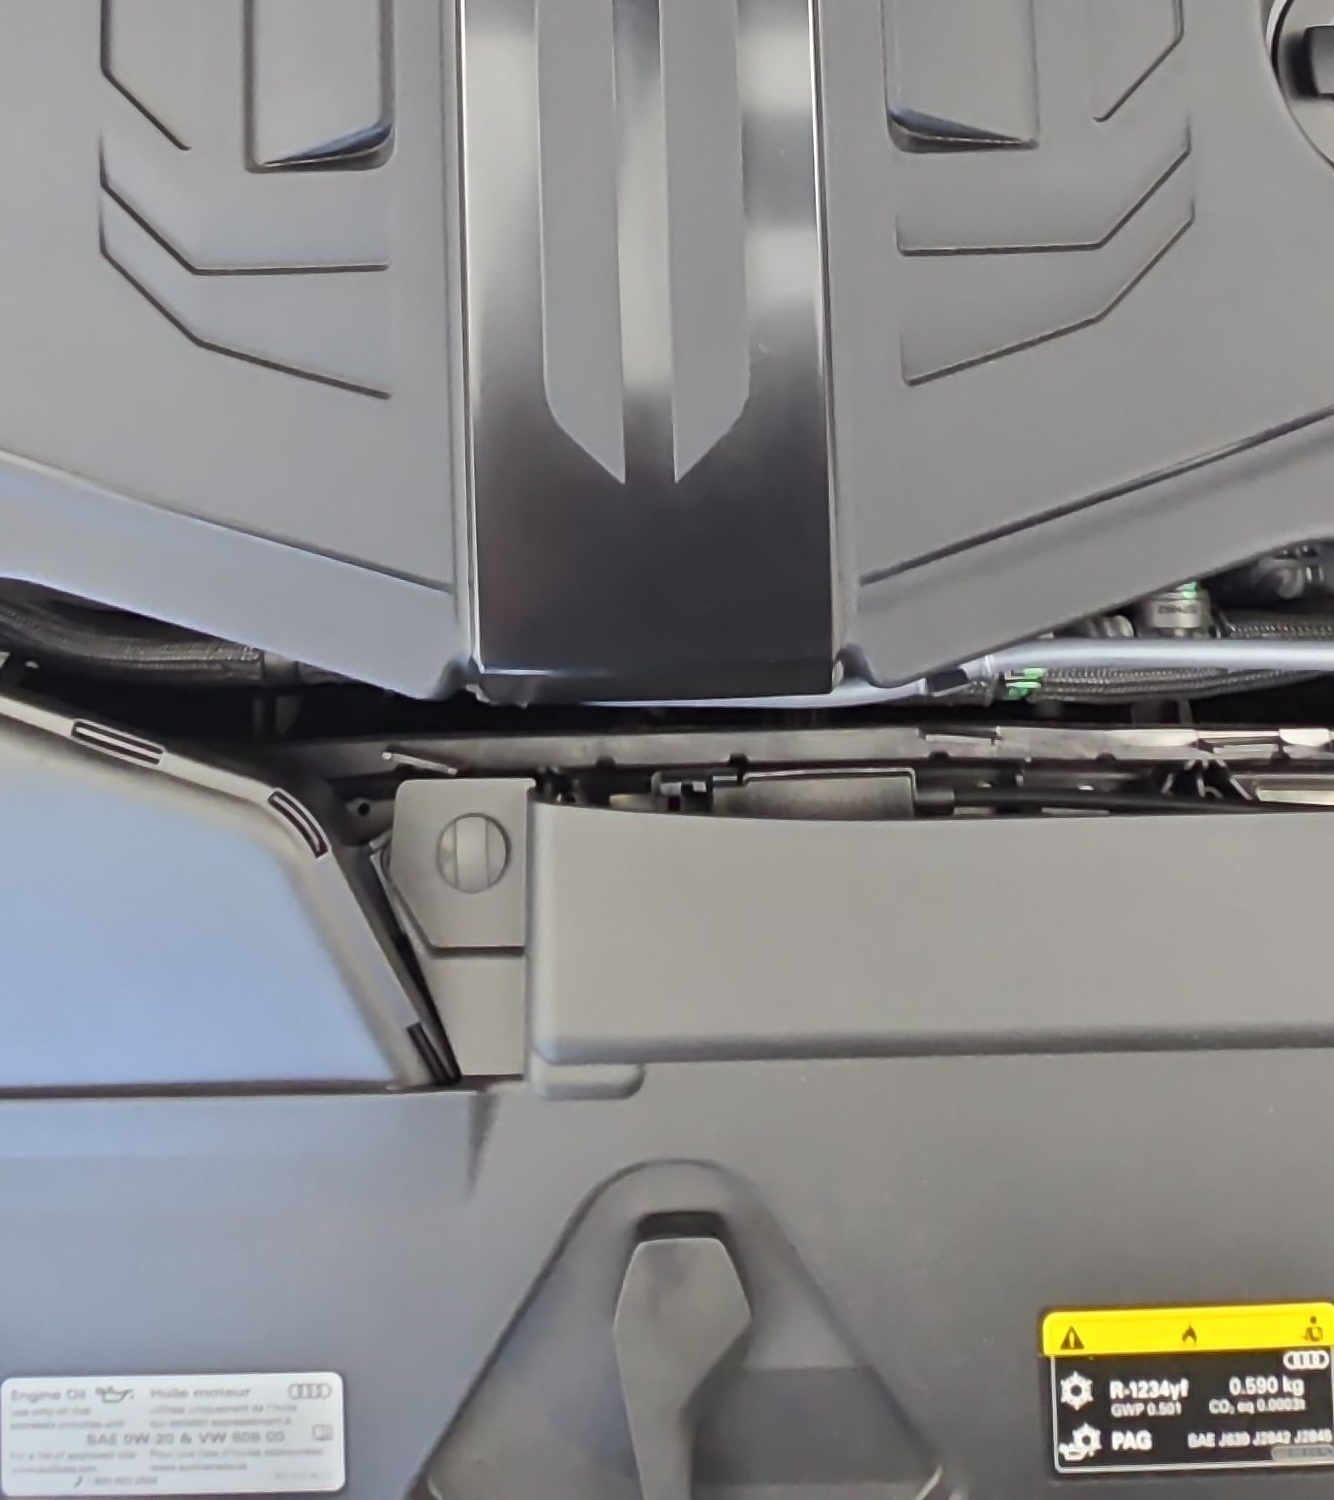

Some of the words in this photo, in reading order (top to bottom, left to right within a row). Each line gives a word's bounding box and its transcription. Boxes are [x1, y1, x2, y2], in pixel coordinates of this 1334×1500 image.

[150, 1387, 189, 1399] Huile
[193, 1387, 251, 1398] moteur
[1110, 1378, 1189, 1401] R-1234yf
[1229, 1375, 1279, 1397] 0.590
[1281, 1373, 1305, 1397] kg
[11, 1388, 62, 1404] Engine
[67, 1388, 86, 1401] Oil
[1110, 1402, 1145, 1418] GWP
[1146, 1400, 1182, 1417] 0.501
[1237, 1400, 1255, 1415] eq
[86, 1432, 117, 1446] SAE
[198, 1430, 227, 1444] VW
[1111, 1429, 1153, 1451] PAG
[1187, 1431, 1216, 1448] SAE
